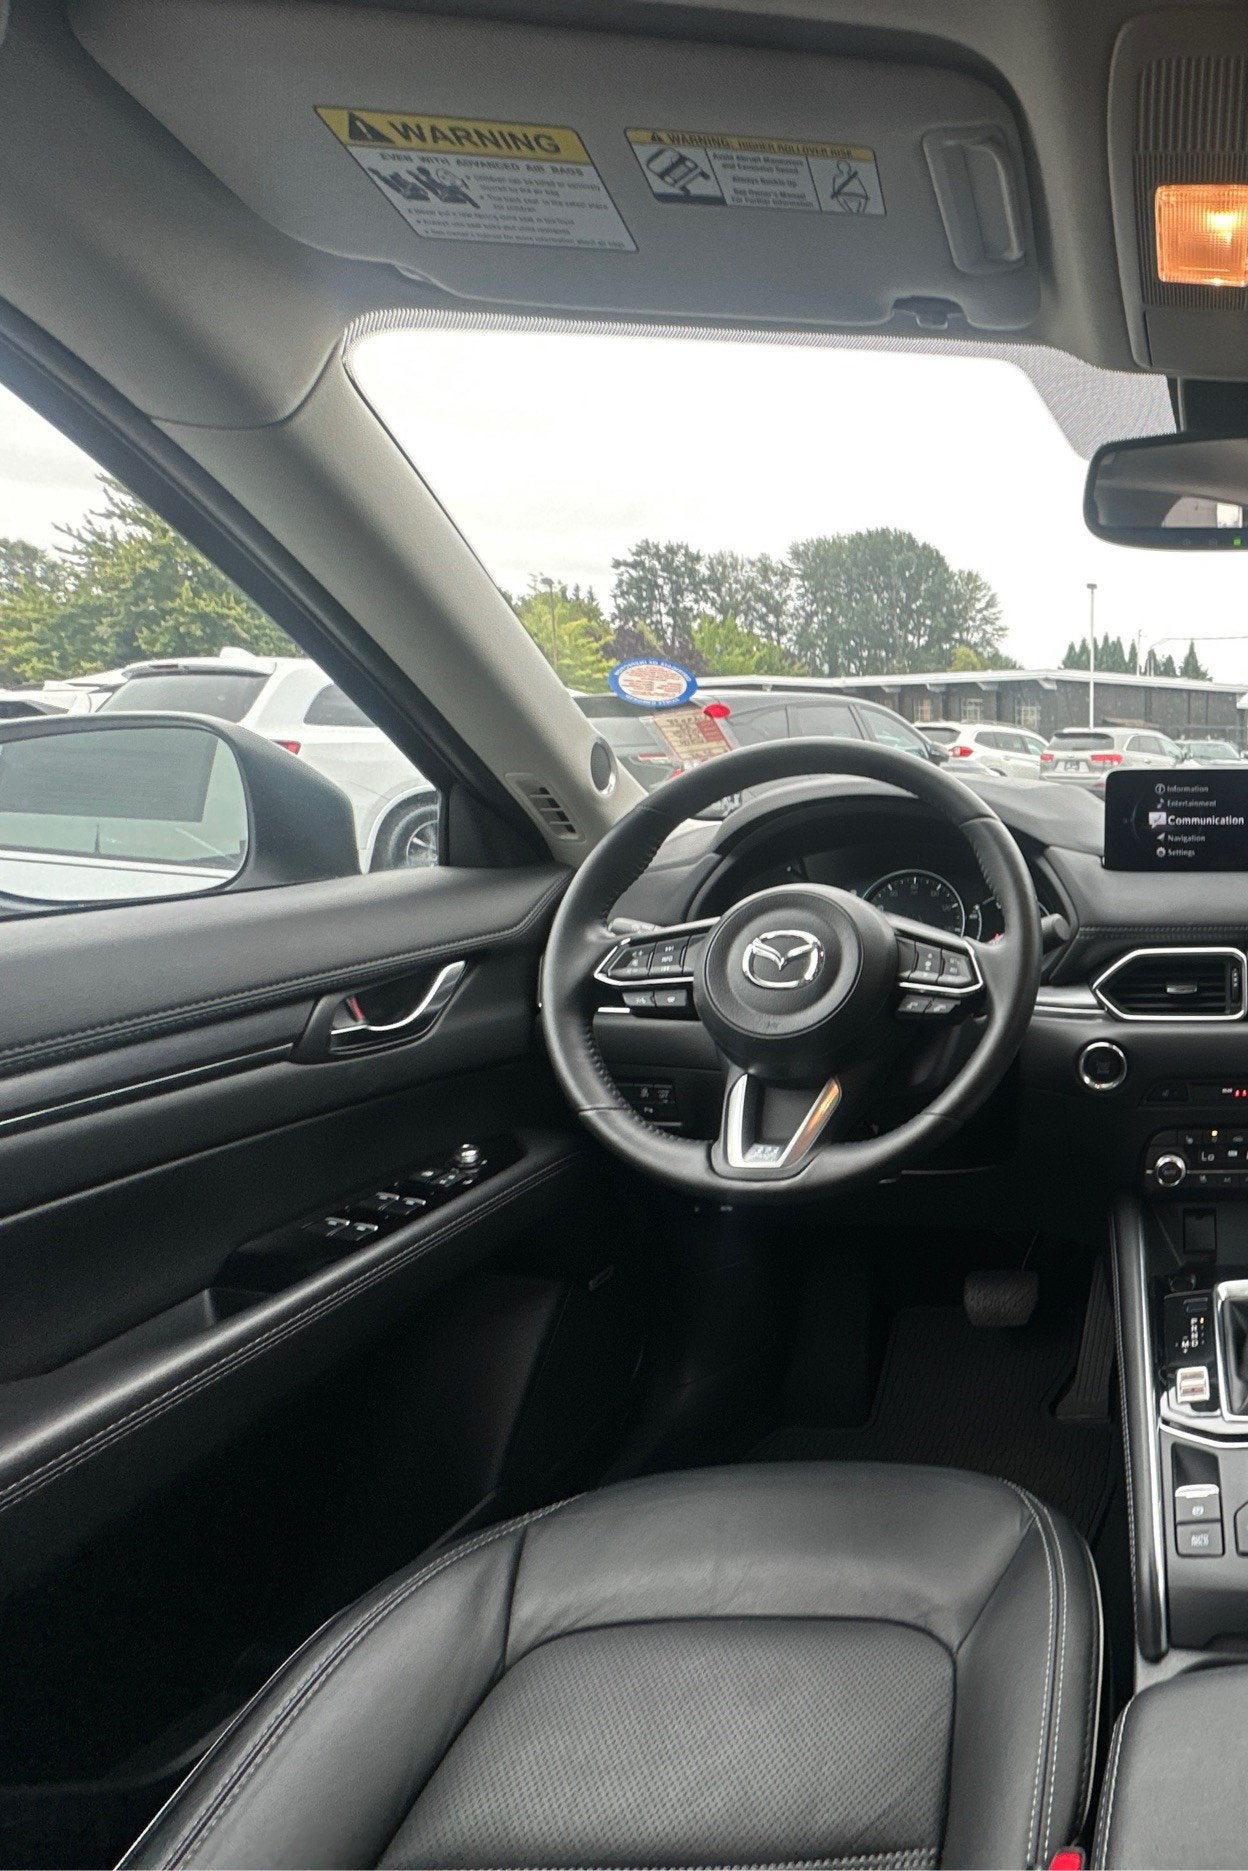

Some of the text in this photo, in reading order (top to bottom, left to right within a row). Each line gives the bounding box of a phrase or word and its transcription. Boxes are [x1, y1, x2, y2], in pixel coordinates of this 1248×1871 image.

[389, 120, 561, 154] WARNING
[380, 152, 584, 177] EVEN WITH ADVANCED AIR BAGS
[1167, 784, 1209, 793] Information
[1167, 799, 1217, 808] Entertainment
[1168, 814, 1245, 826] Communication
[1167, 834, 1206, 844] Navigation
[1167, 848, 1196, 858] Settings
